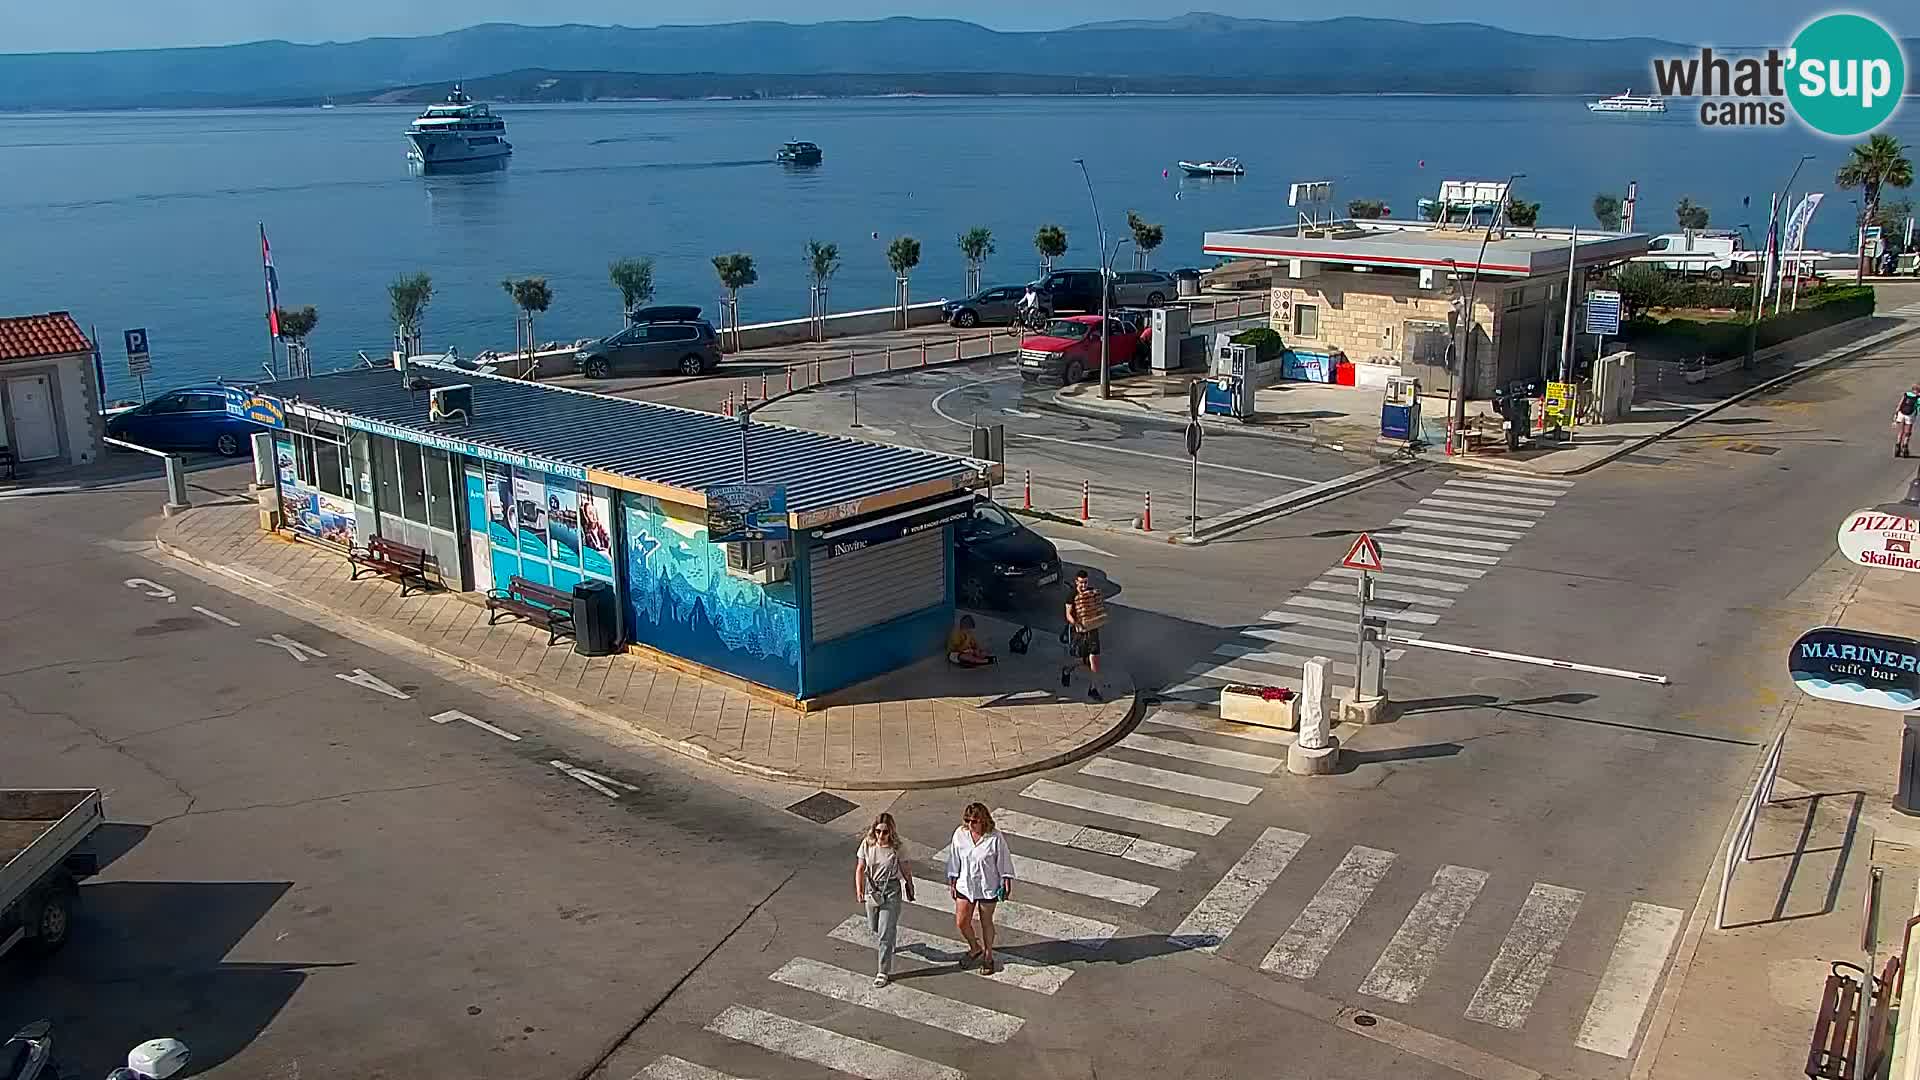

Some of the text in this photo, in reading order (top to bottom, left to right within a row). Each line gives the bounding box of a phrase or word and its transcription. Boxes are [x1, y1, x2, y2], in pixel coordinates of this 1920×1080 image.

[130, 333, 141, 350] P
[395, 430, 436, 446] AUTOBUSNA
[436, 439, 467, 454] POSTAJA
[478, 447, 493, 459] BUS
[493, 451, 526, 466] STATION
[527, 457, 553, 473] TICKET
[555, 464, 583, 478] OFFICE
[1848, 516, 1920, 534] PIZZE
[1882, 531, 1917, 542] GRILL
[1801, 642, 1920, 675] MARINER
[1829, 663, 1899, 682] caffe bar
